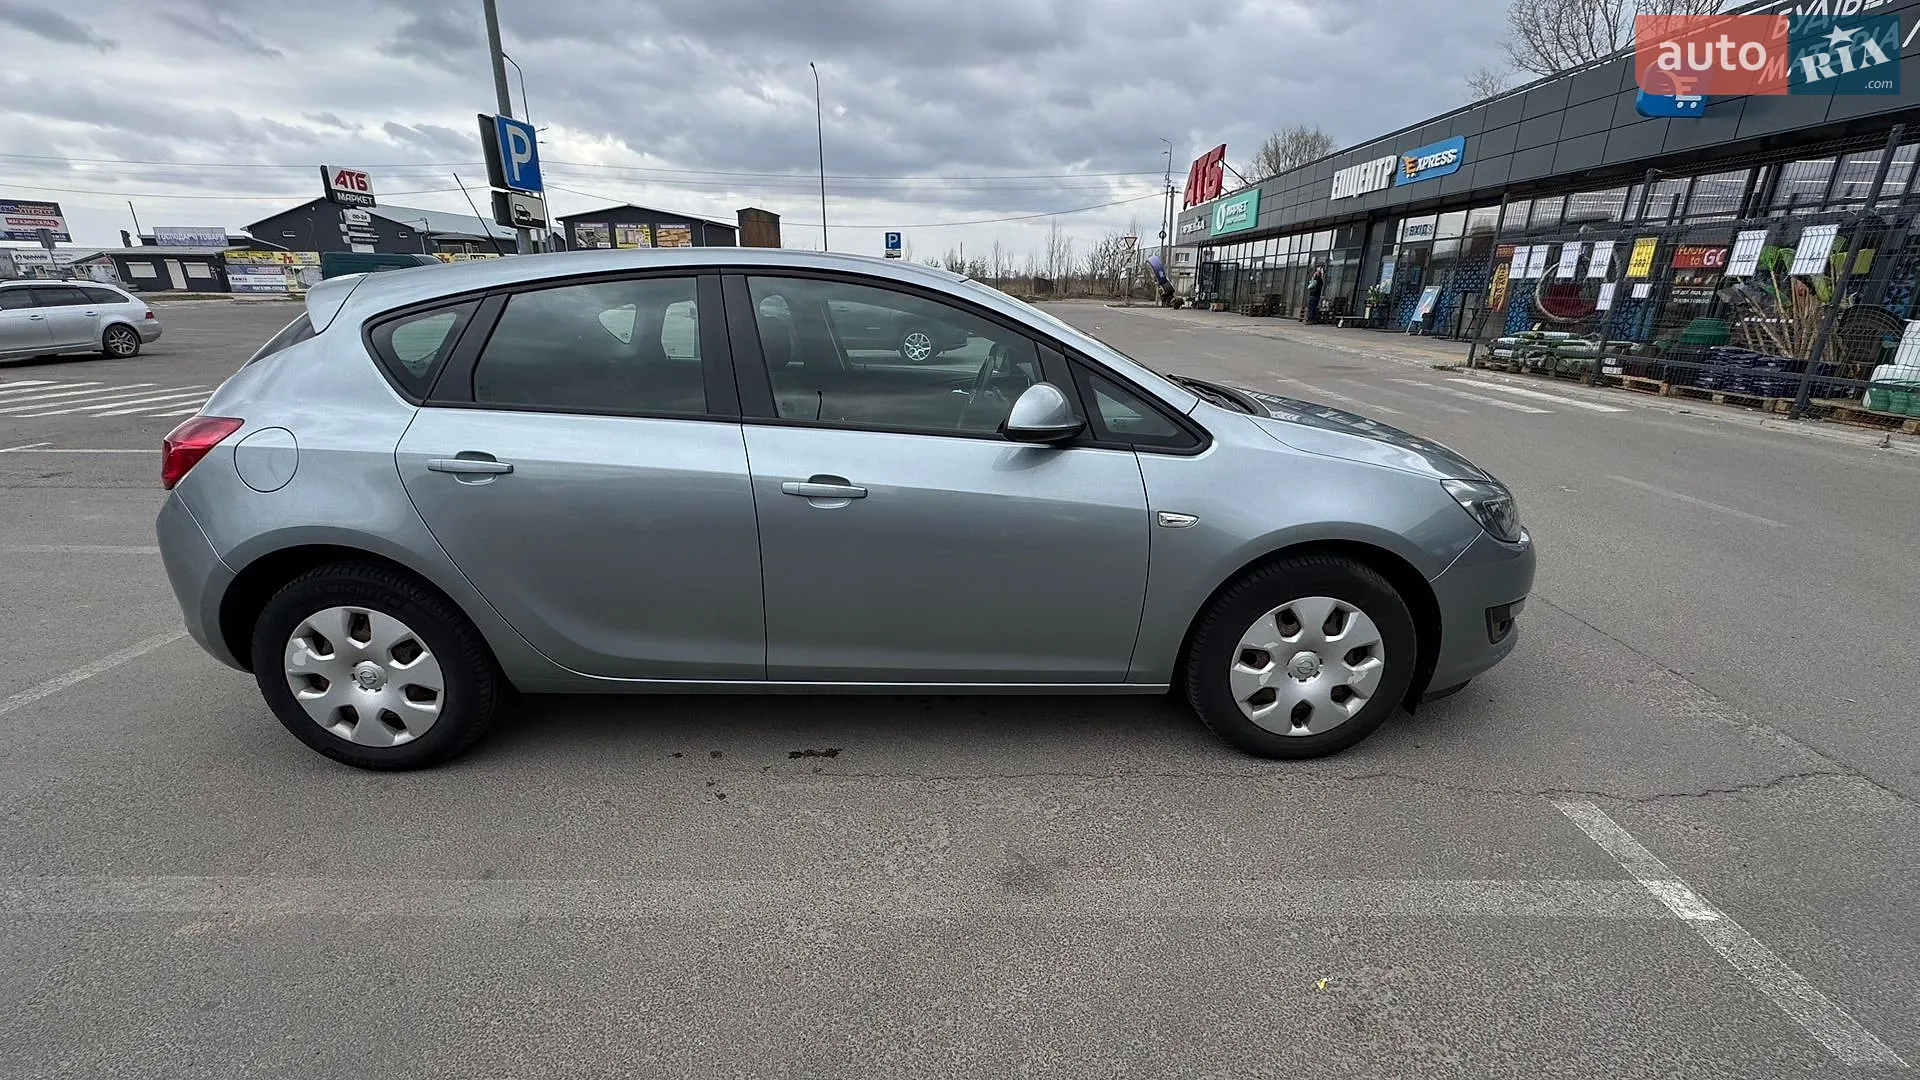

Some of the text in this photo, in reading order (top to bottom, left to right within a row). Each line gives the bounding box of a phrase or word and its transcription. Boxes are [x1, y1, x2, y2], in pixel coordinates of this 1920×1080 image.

[505, 123, 532, 182] P
[1402, 148, 1458, 174] EXPRESS
[334, 169, 368, 192] АТБ
[1183, 144, 1226, 211] АТБ
[336, 192, 374, 205] МАРКЕТ
[888, 233, 899, 248] P
